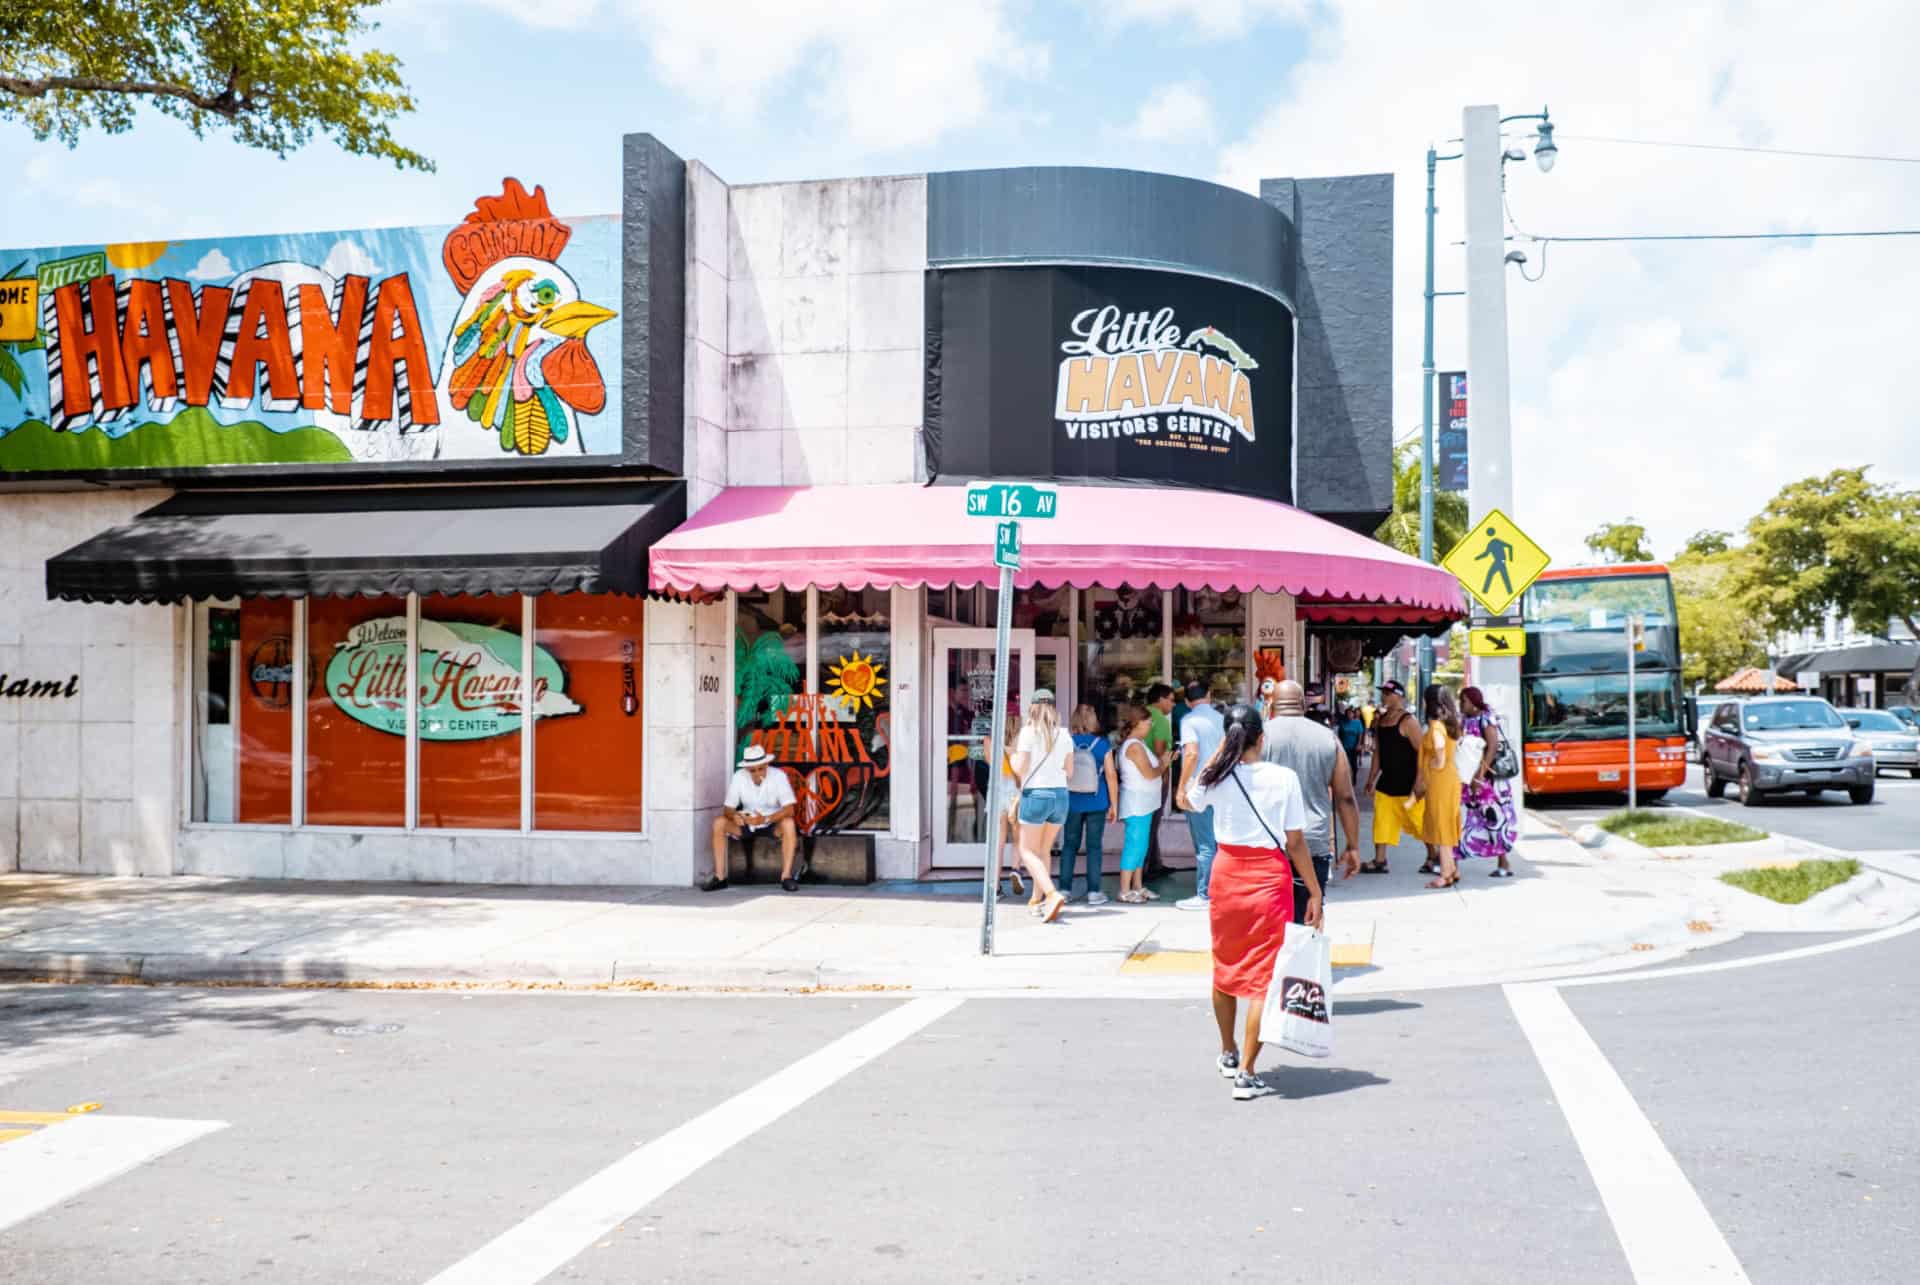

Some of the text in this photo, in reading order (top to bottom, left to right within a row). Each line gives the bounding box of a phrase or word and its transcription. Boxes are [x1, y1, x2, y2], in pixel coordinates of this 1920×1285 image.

[40, 259, 100, 290] LITTLE
[1061, 305, 1181, 354] Little
[46, 272, 441, 432] HAVANA
[1057, 350, 1255, 440] HAVANA
[1065, 415, 1231, 442] VISITORS CENTER
[968, 489, 1054, 515] SW 16 AV
[1259, 627, 1284, 638] SVG
[449, 720, 498, 731] CENTER
[751, 728, 872, 763] MIAMI
